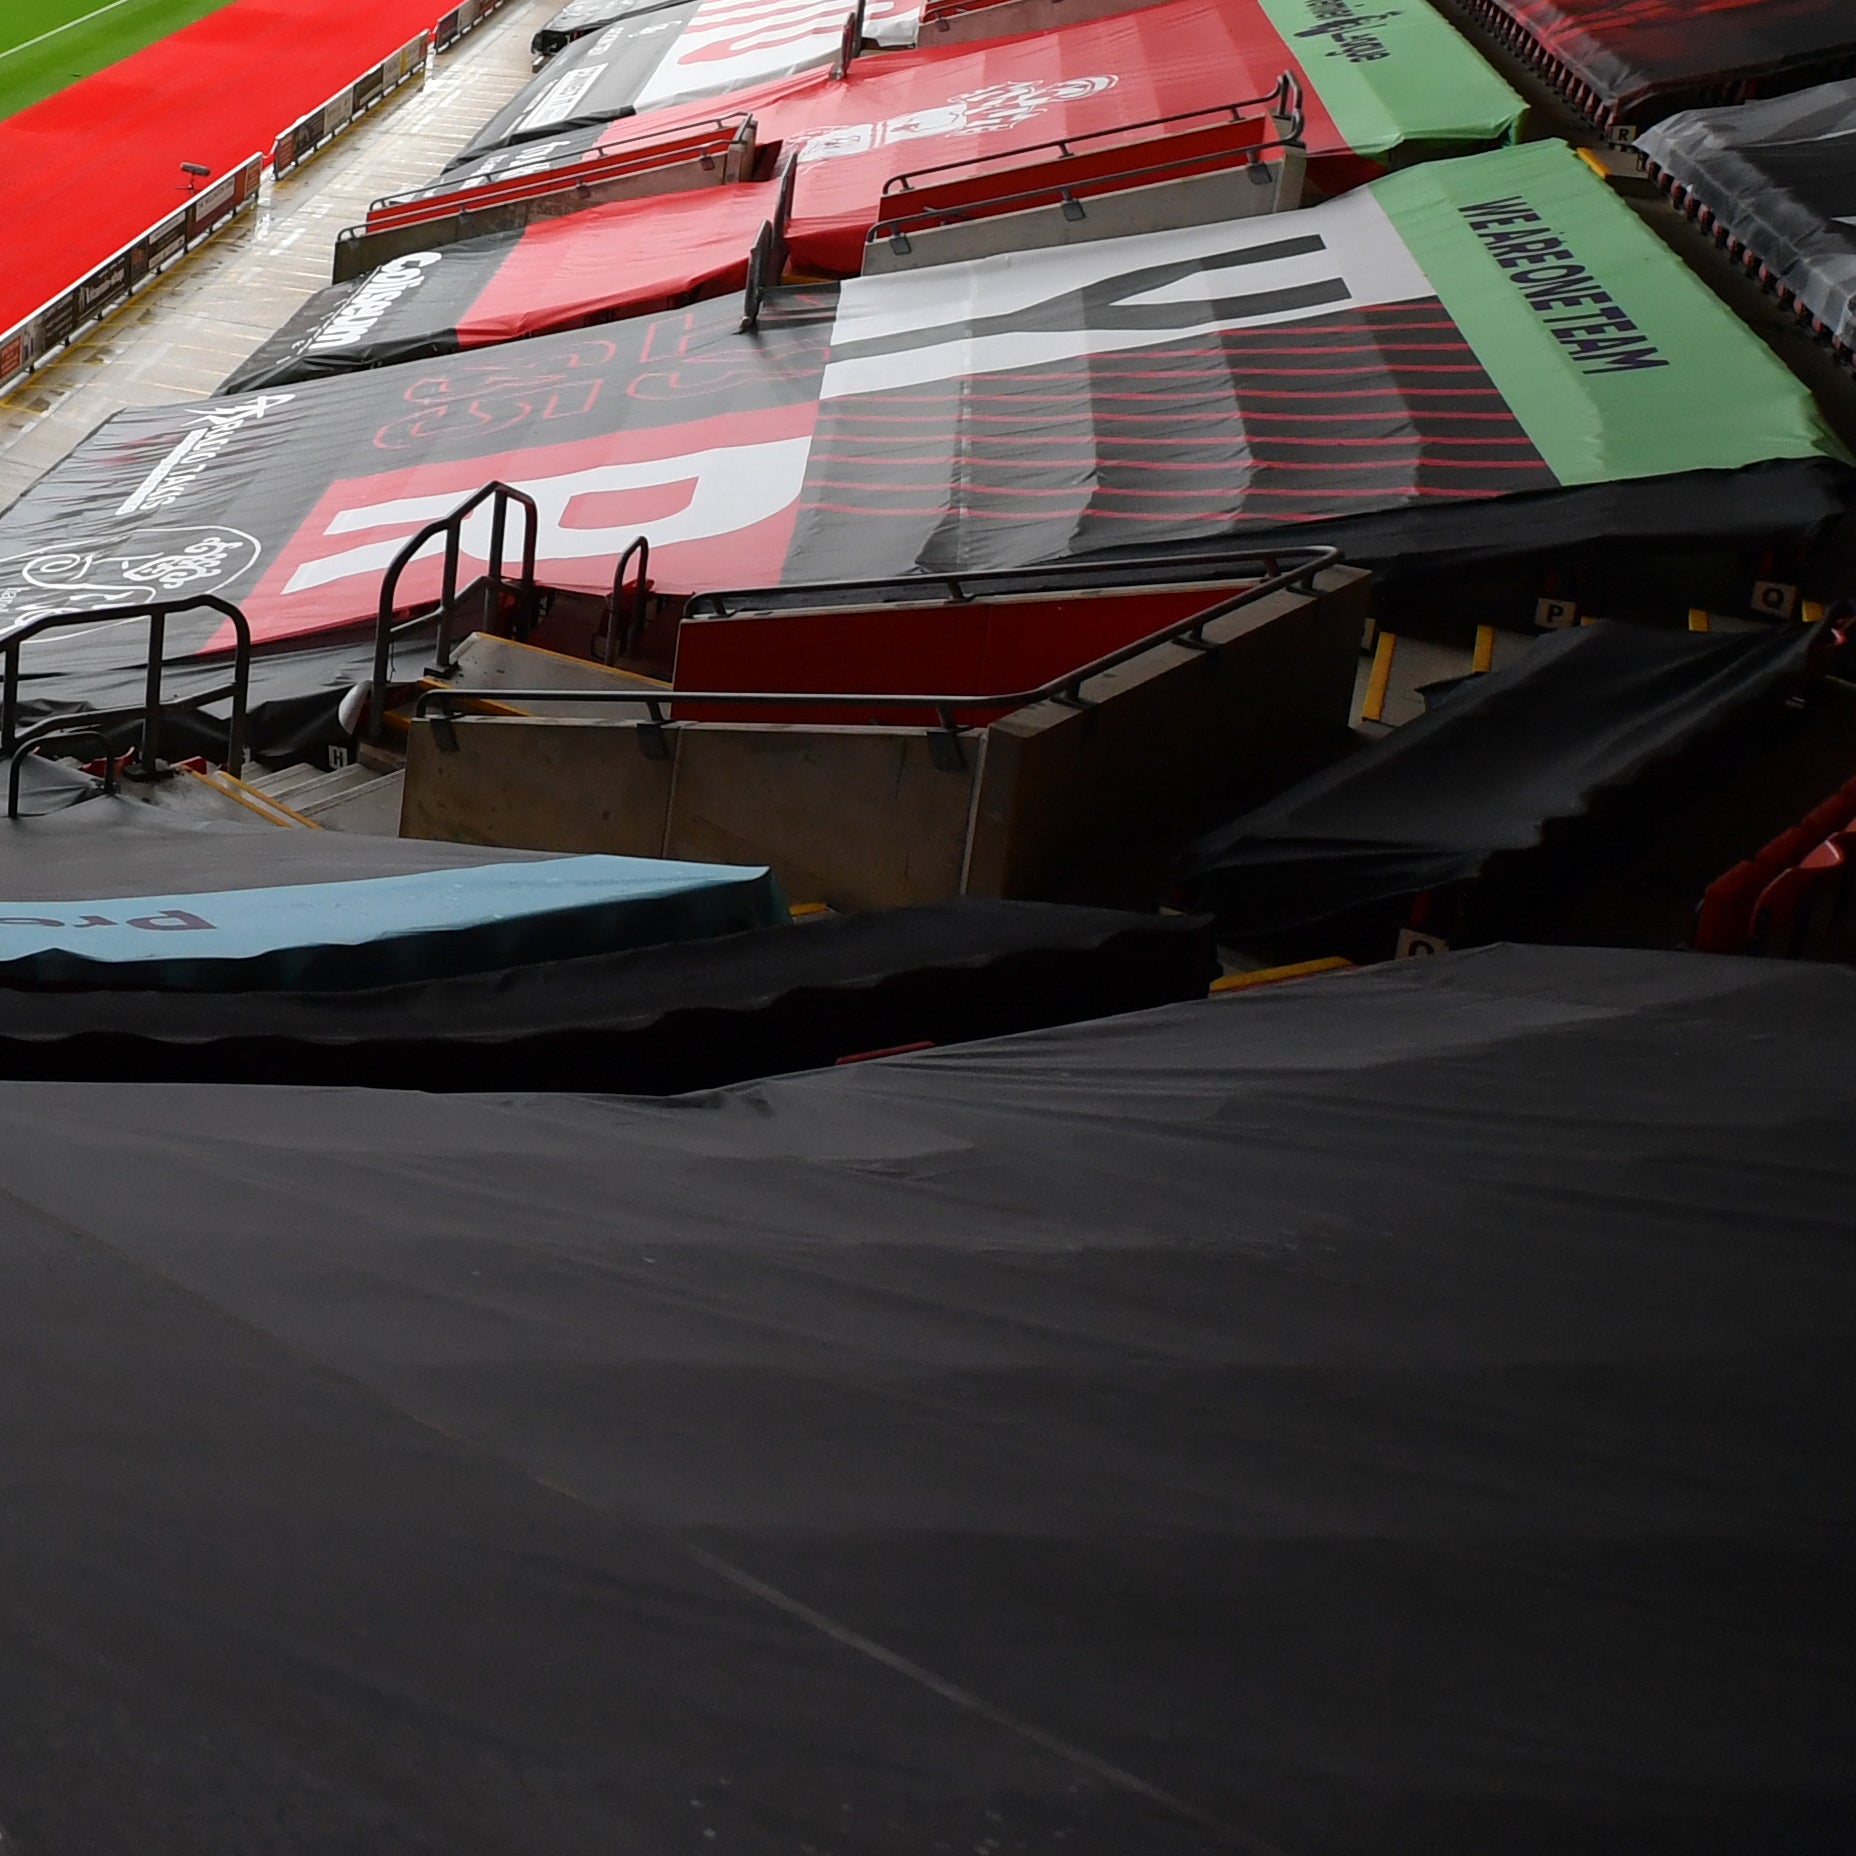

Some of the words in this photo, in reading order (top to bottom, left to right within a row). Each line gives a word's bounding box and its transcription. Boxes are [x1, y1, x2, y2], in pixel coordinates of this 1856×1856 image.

[1457, 195, 1542, 231] WE
[1476, 227, 1575, 269] ARE
[1509, 264, 1614, 312] ONE
[1542, 305, 1671, 375] TEAM
[1545, 604, 1563, 624] P
[1762, 587, 1784, 612] Q
[331, 747, 348, 767] H
